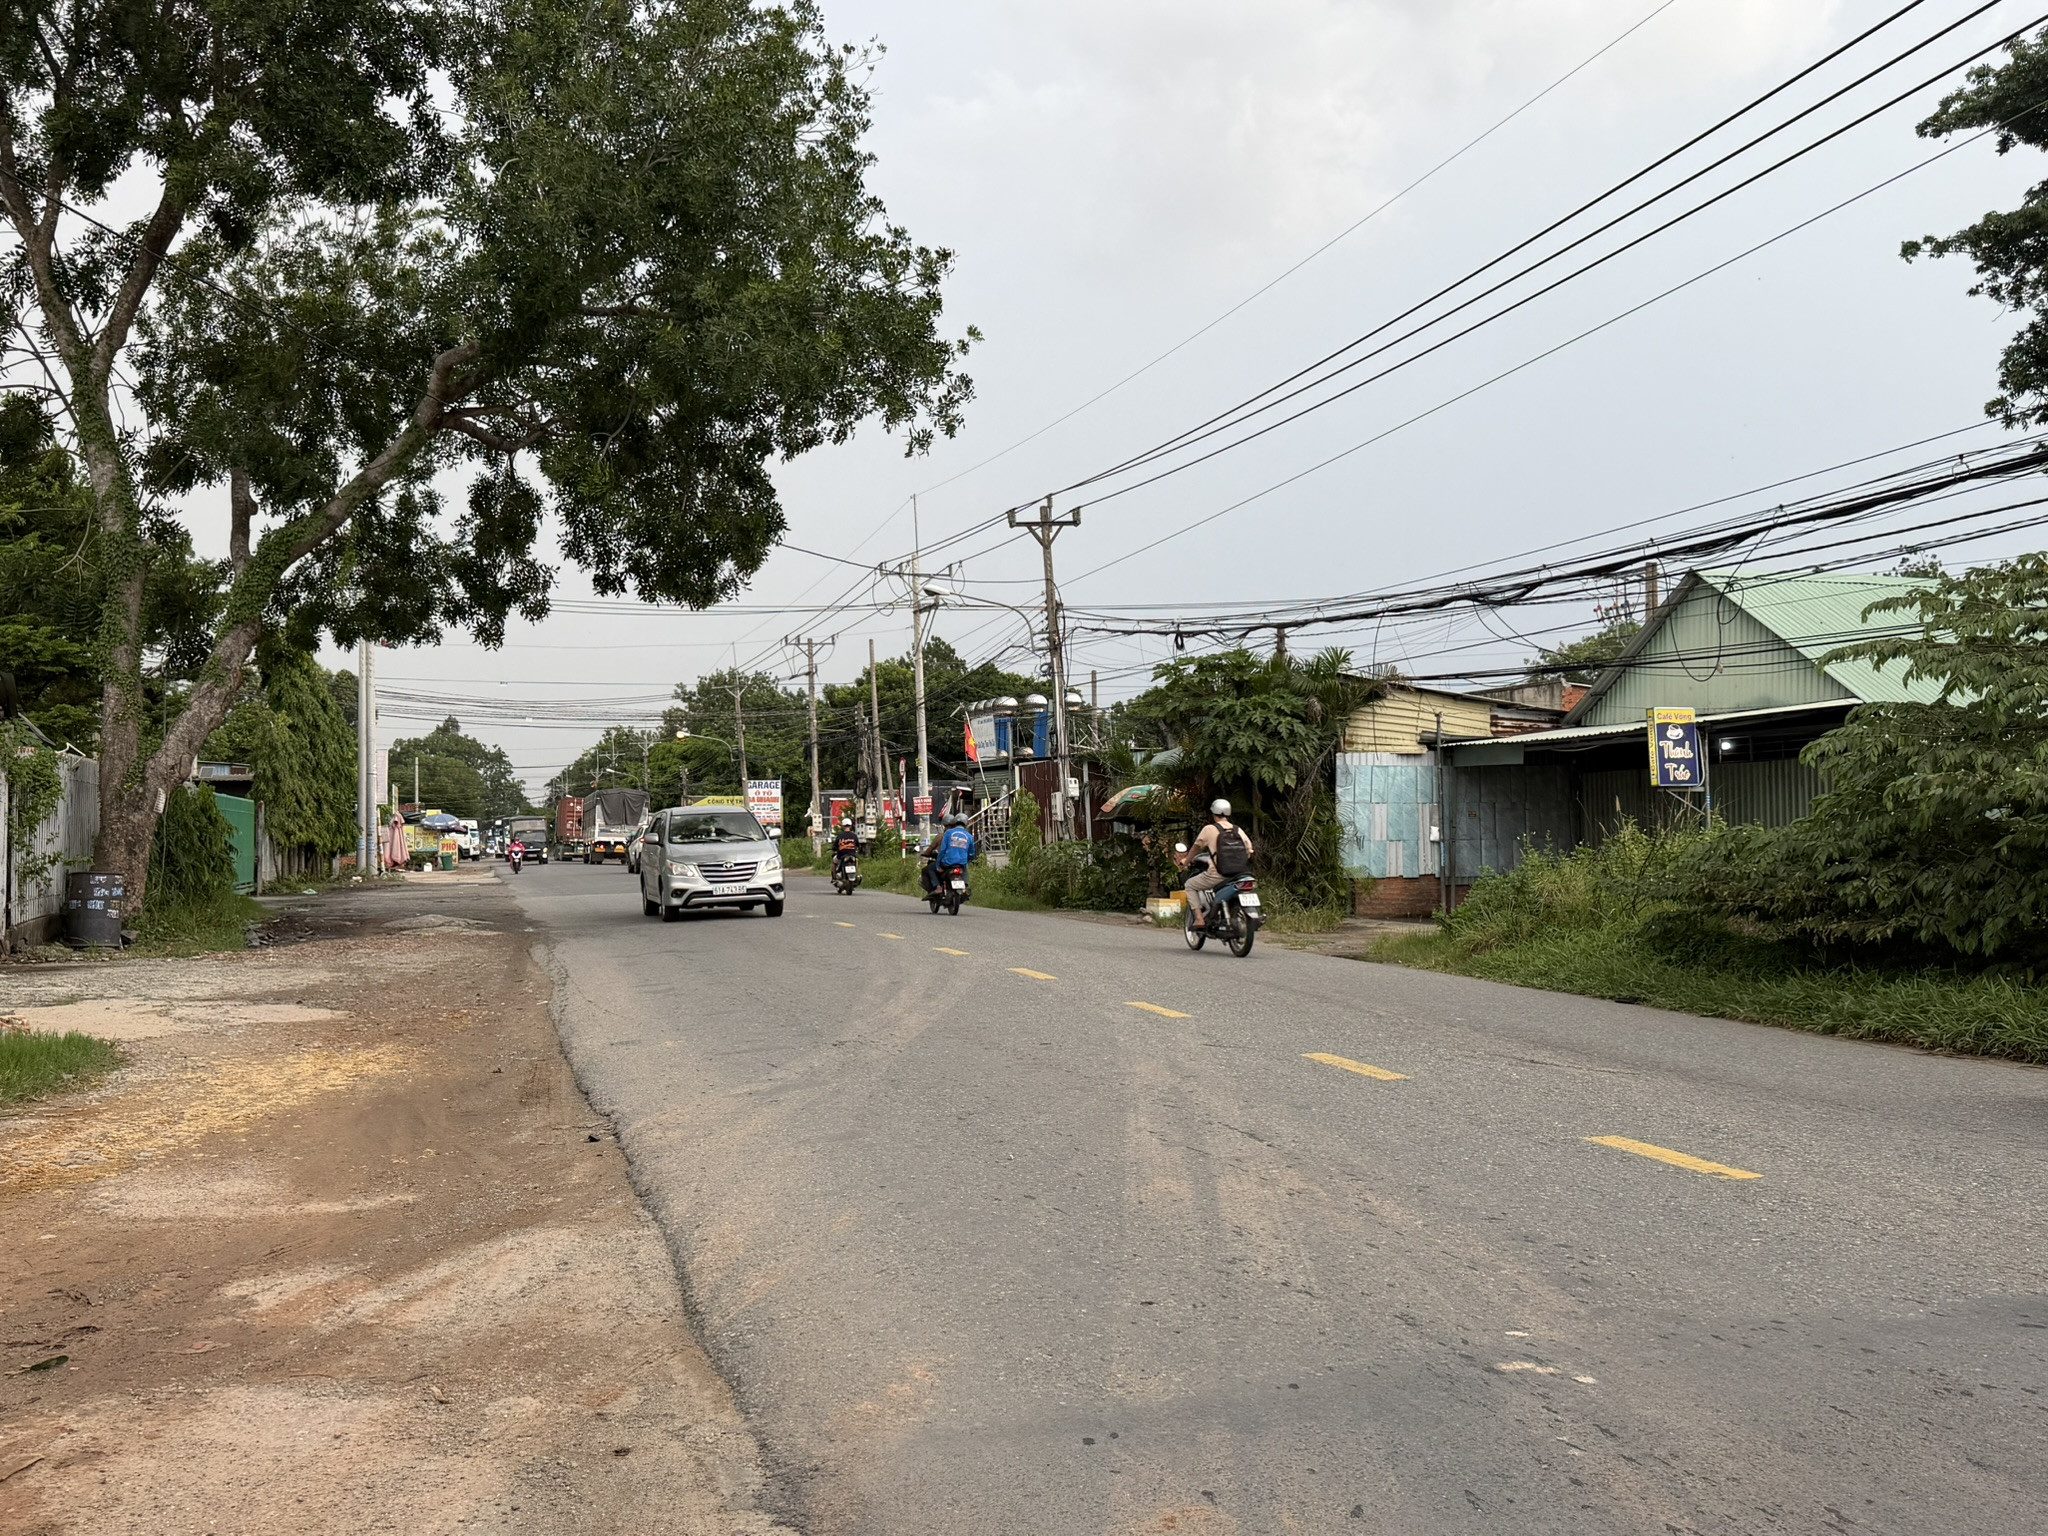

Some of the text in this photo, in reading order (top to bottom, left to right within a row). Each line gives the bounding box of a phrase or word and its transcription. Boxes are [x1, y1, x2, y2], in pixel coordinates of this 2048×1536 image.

[1656, 712, 1673, 720] Café
[1659, 740, 1694, 759] Thanh
[747, 781, 780, 789] GARAGE
